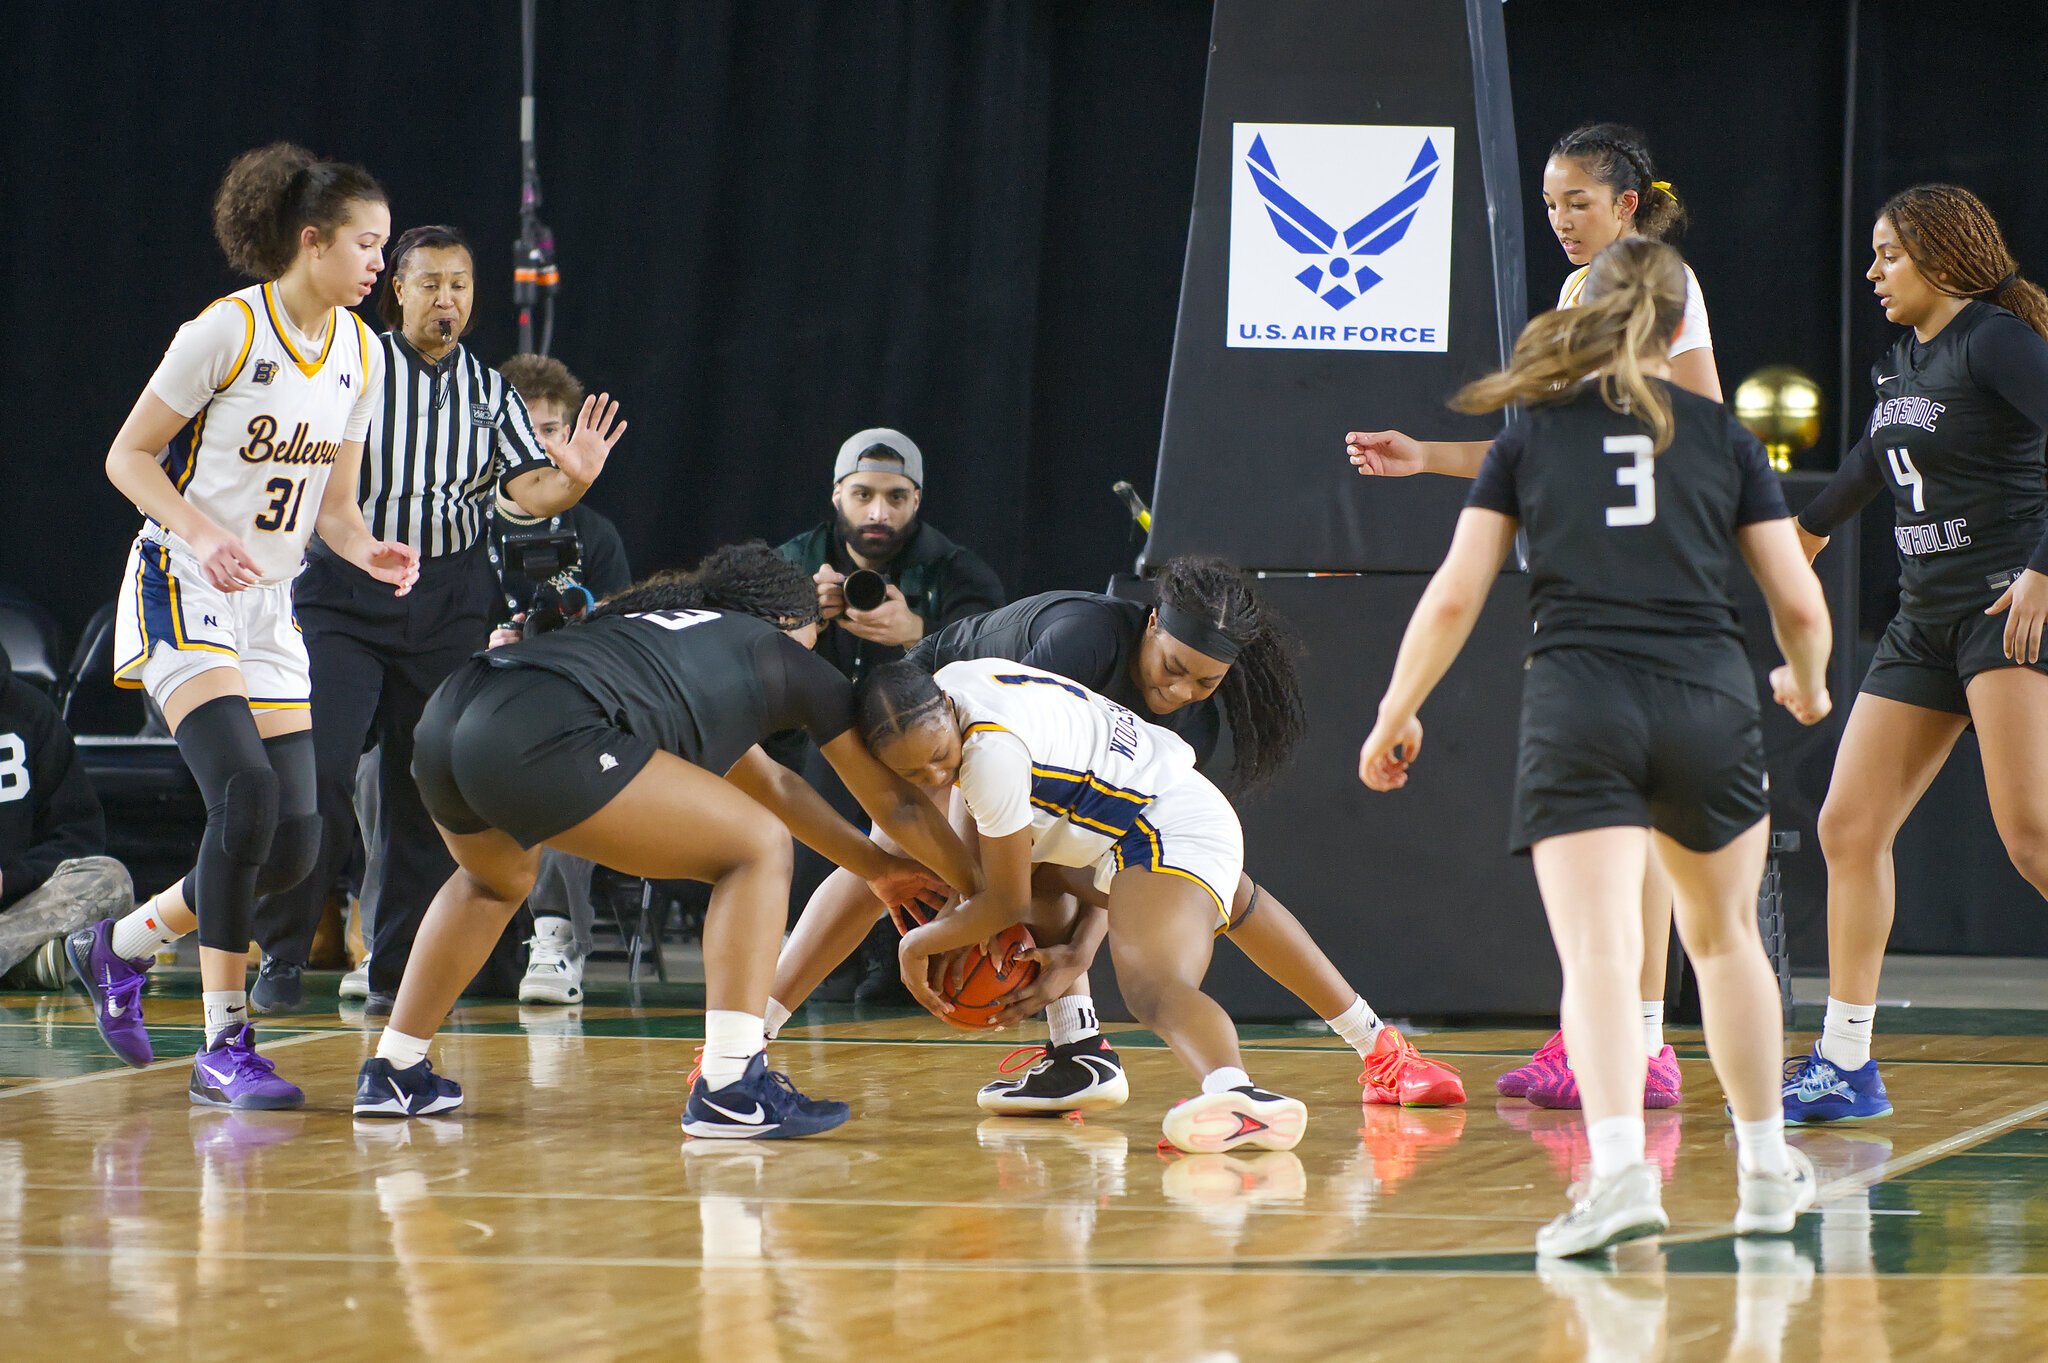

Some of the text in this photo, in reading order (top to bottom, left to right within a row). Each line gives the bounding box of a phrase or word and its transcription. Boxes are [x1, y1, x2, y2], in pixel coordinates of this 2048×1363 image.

[1239, 323, 1436, 343] U.S. AIR FORCE
[239, 414, 341, 467] Bellevu
[254, 475, 308, 533] 31
[1602, 434, 1657, 527] 3
[1886, 448, 1926, 513] 4
[991, 674, 1092, 703] 1
